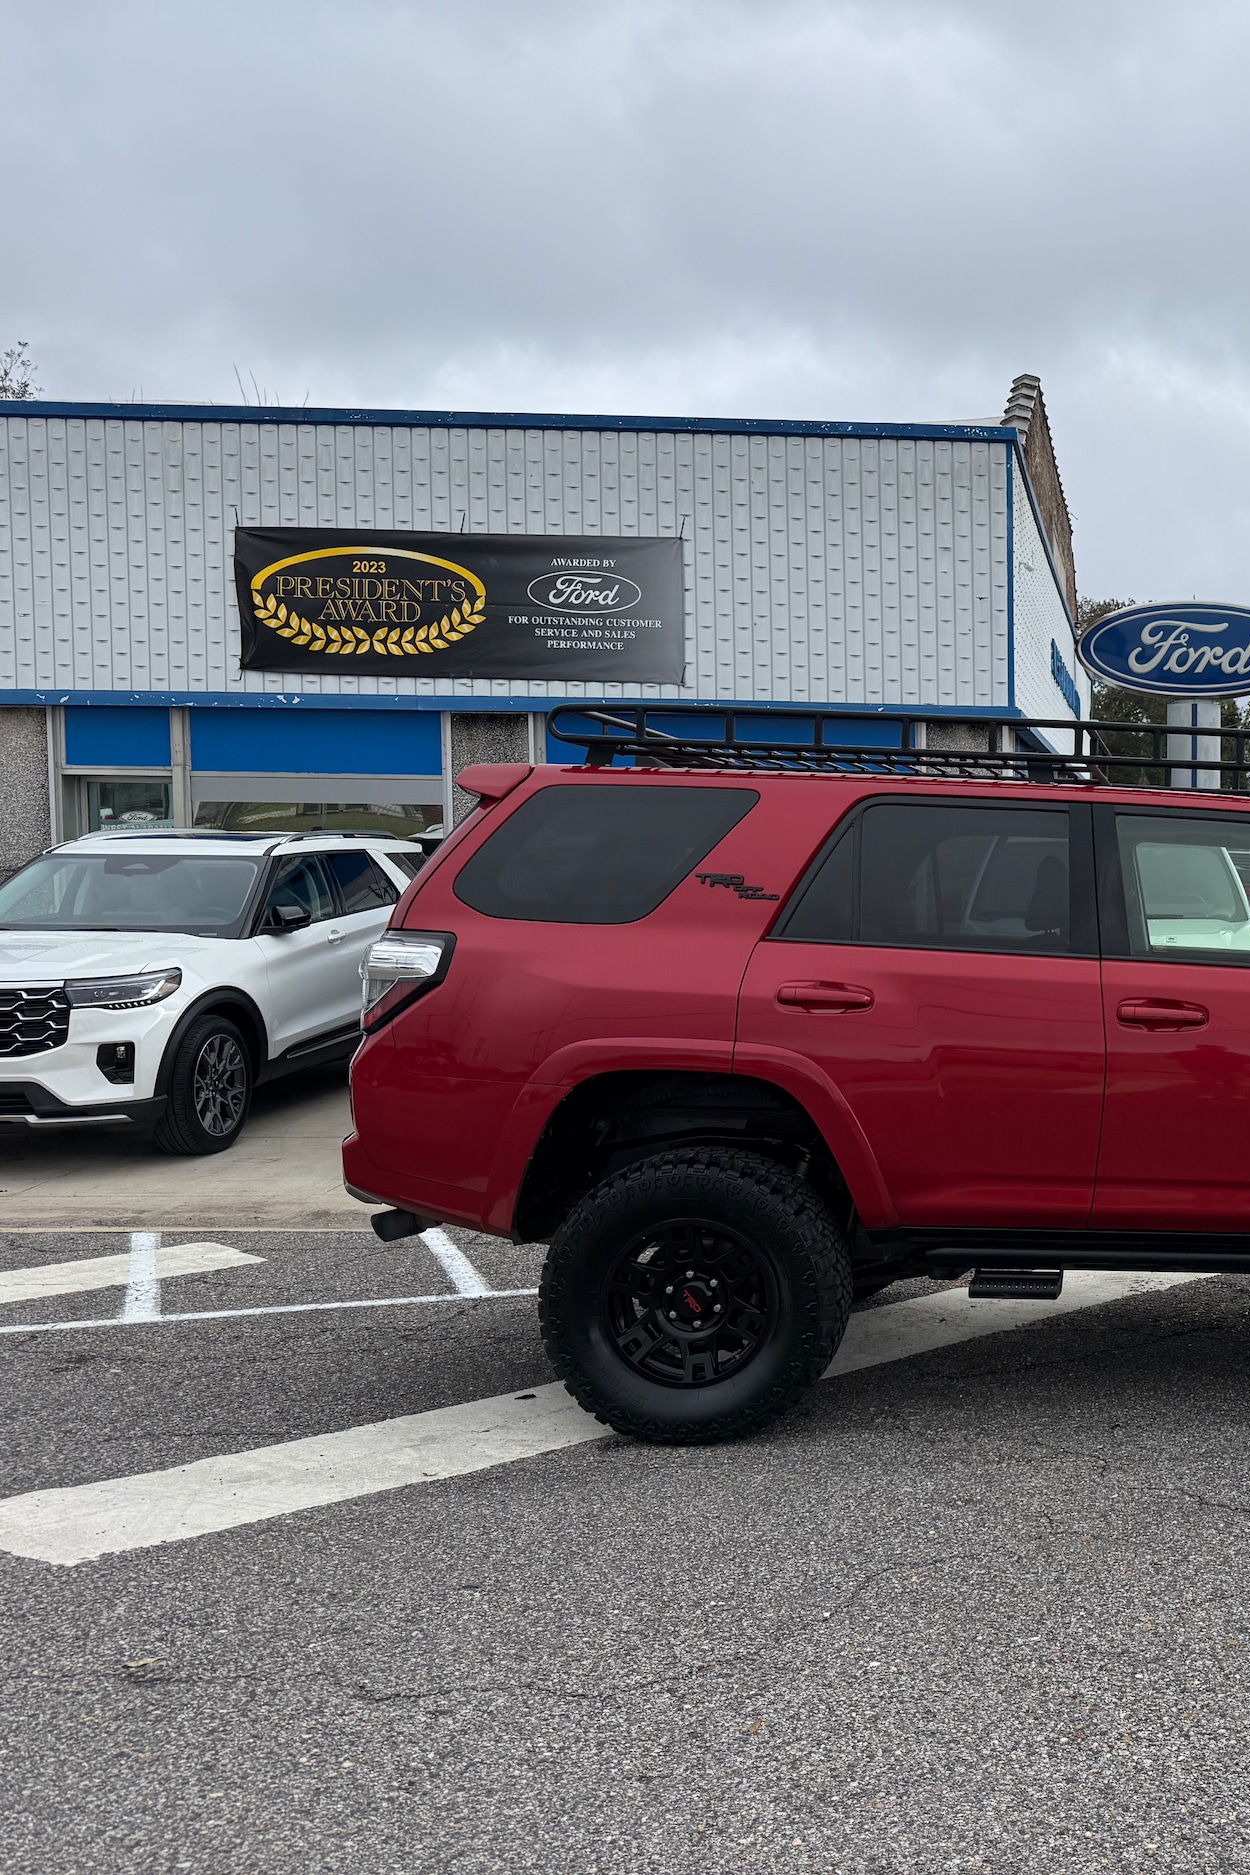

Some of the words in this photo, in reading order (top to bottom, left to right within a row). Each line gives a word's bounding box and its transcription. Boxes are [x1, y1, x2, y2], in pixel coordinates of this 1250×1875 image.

[352, 561, 387, 574] 2023
[551, 558, 600, 567] AWARDED
[603, 559, 616, 568] BY
[275, 575, 467, 602] PRESIDENT'S
[548, 575, 620, 605] Ford
[318, 599, 421, 623] AWARD
[508, 616, 529, 625] FOR
[532, 616, 604, 627] OUTSTANDING
[606, 618, 662, 628] CUSTOMER
[535, 628, 578, 638] SERVICE
[581, 629, 602, 638] AND
[605, 630, 636, 639] SALES
[547, 640, 625, 650] PERFORMANCE
[126, 812, 149, 821] Ford
[695, 873, 744, 888] TRD
[683, 1290, 701, 1312] TRD
